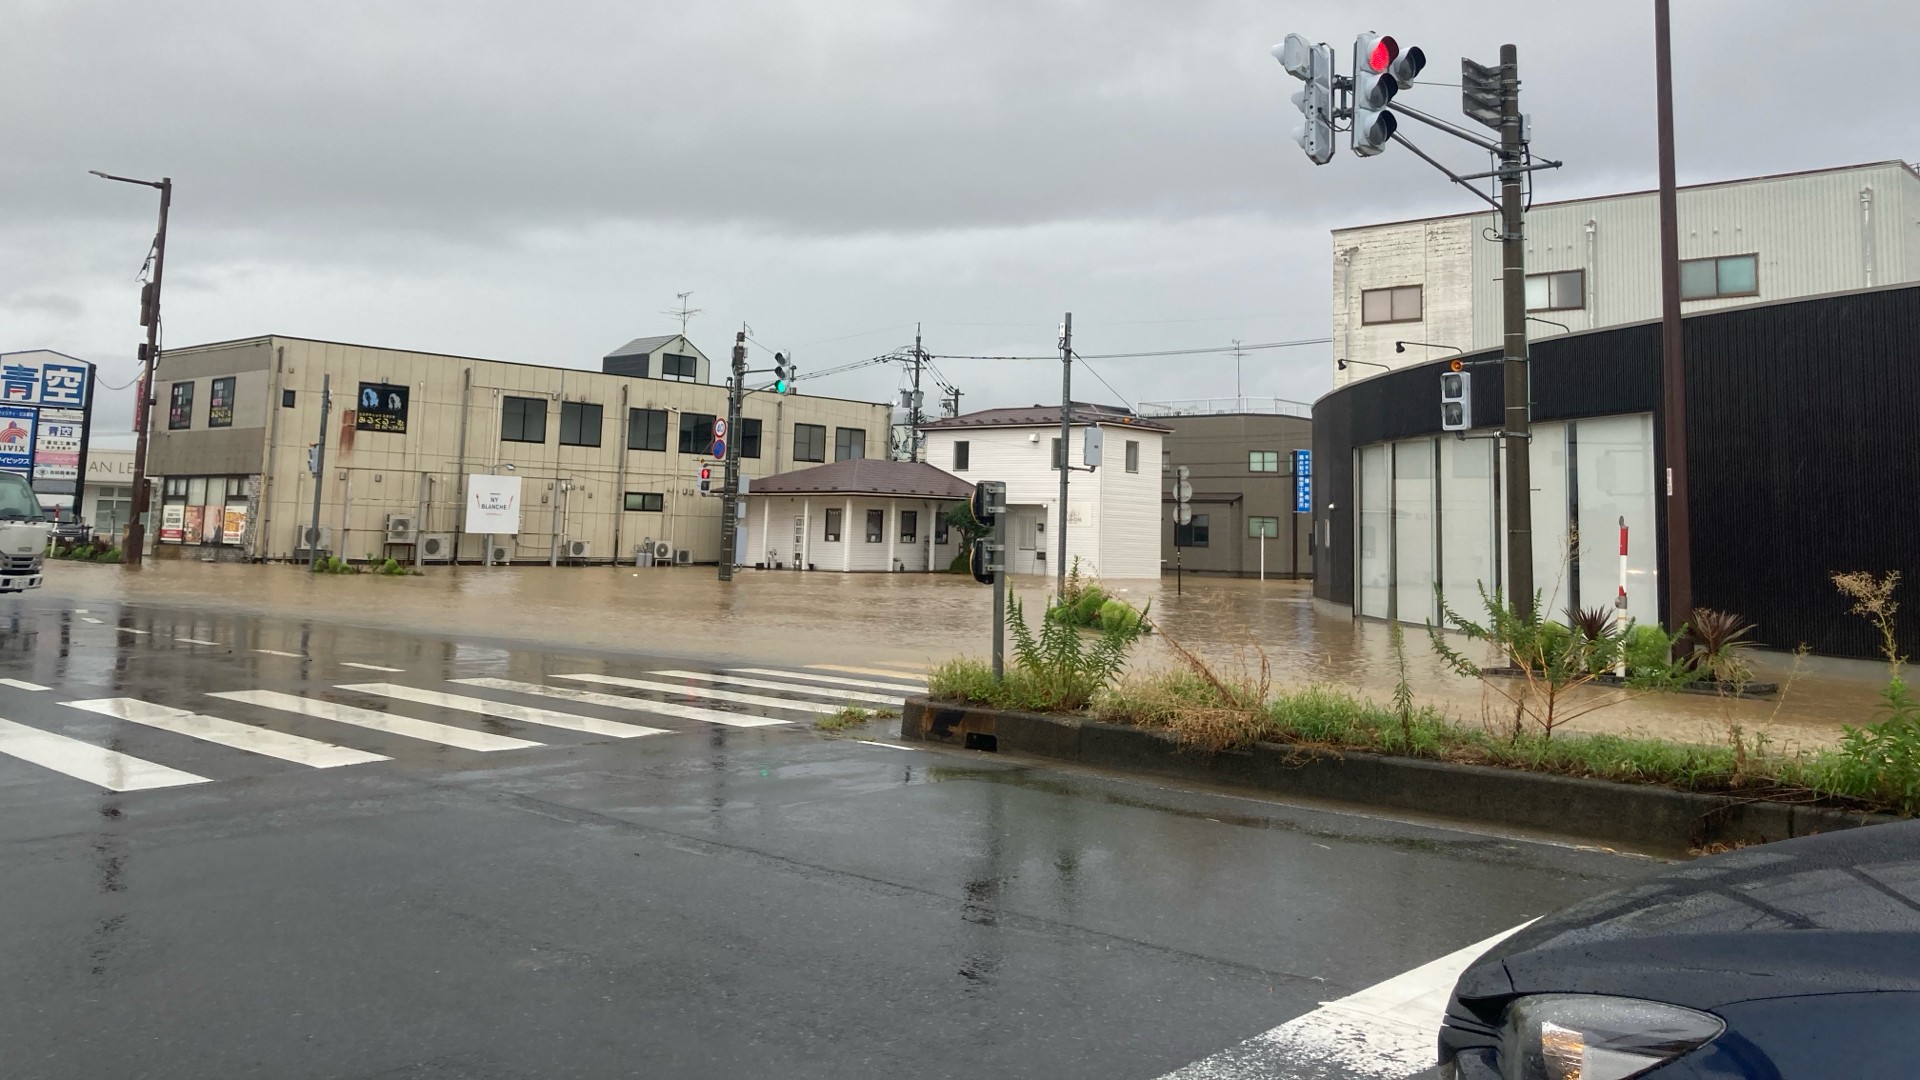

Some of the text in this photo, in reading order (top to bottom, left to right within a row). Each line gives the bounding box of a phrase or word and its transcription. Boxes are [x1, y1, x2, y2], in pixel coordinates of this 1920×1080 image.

[1, 363, 82, 404] 青空
[717, 423, 725, 433] 40
[0, 456, 30, 465] イビックス
